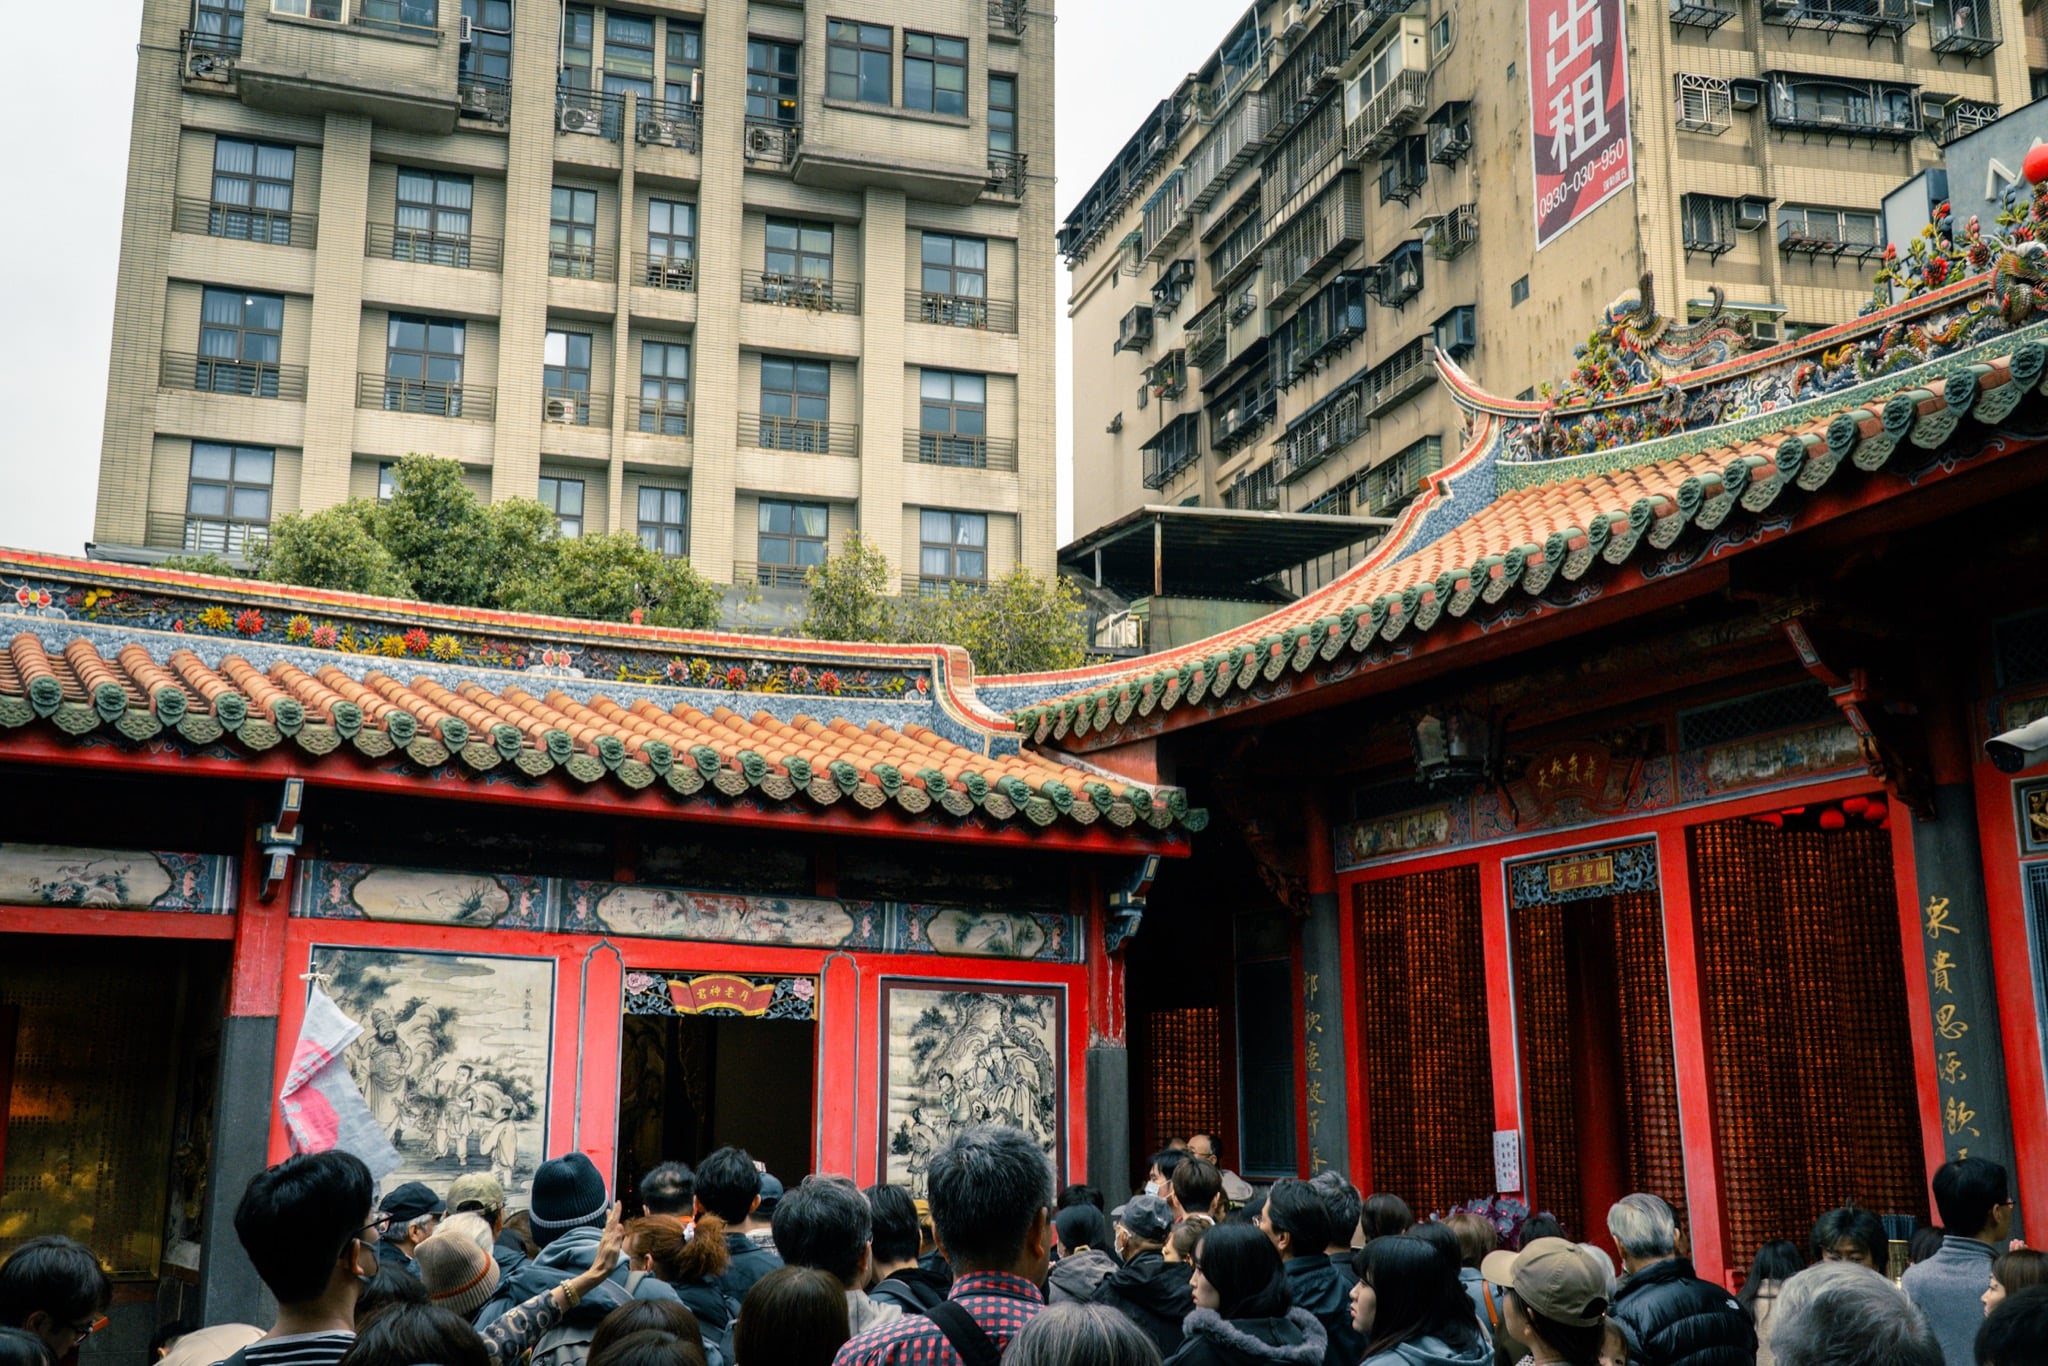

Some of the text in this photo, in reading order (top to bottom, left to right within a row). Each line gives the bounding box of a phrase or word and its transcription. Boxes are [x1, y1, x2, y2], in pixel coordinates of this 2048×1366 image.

[1547, 0, 1610, 173] 出租
[1540, 138, 1625, 217] 0930-030-950
[1554, 861, 1609, 886] 關聖帝君
[696, 984, 749, 1002] 月老神君
